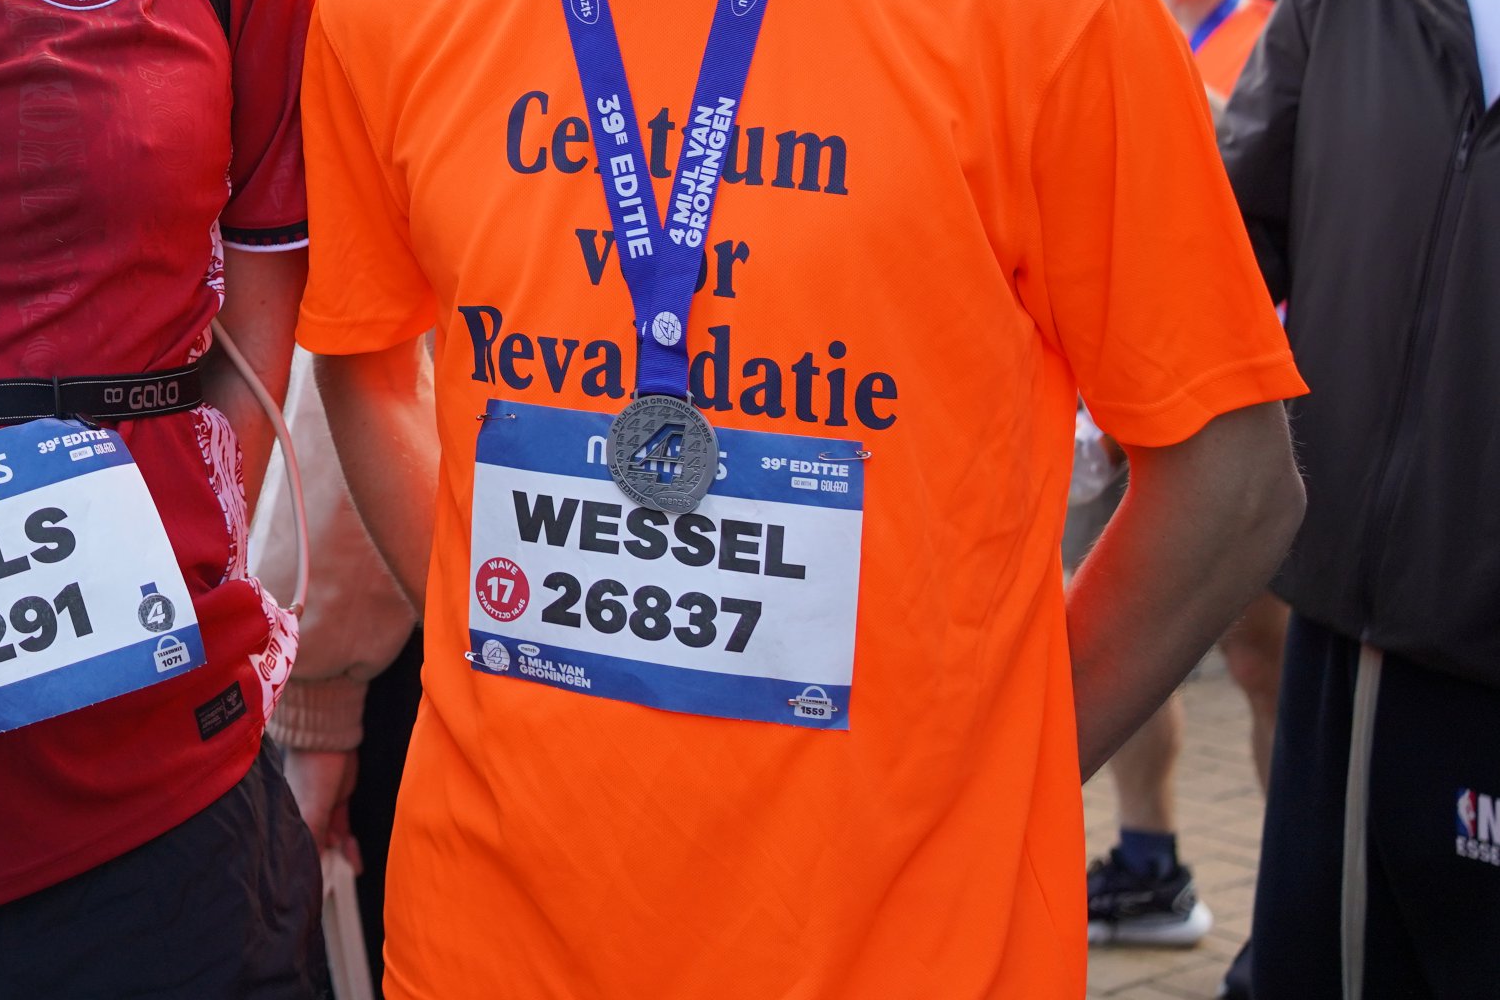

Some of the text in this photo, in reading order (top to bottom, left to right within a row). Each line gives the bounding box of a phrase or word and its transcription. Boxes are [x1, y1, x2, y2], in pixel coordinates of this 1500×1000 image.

[506, 90, 849, 195] Cetum
[596, 94, 653, 259] 39E EDITIE
[669, 105, 715, 245] 4 MIJL VAN
[685, 96, 736, 248] GRONINGEN
[575, 228, 750, 298] vr
[457, 305, 898, 431] Revadatie
[614, 410, 631, 428] MIJL
[630, 400, 648, 411] VAN
[650, 399, 701, 424] GRONINGEN
[699, 422, 713, 444] 2026
[37, 430, 110, 454] 39E EDITIE
[93, 442, 116, 455] GOLAZO
[627, 423, 687, 485] 4
[761, 457, 849, 477] 39E EDITIE
[618, 480, 647, 505] EDITIE
[821, 480, 848, 493] GOLAZO
[659, 496, 691, 506] menzis
[512, 489, 806, 580] WESSEL
[488, 560, 519, 575] WAVE
[487, 576, 515, 604] 17
[146, 600, 166, 624] 4
[478, 590, 526, 619] STARTTIJD 14.45
[541, 571, 762, 653] 26837
[161, 655, 183, 667] 1071
[527, 657, 556, 671] MIJL
[557, 663, 585, 677] VAN
[519, 665, 591, 689] GRONINGEN
[801, 706, 825, 716] 1559
